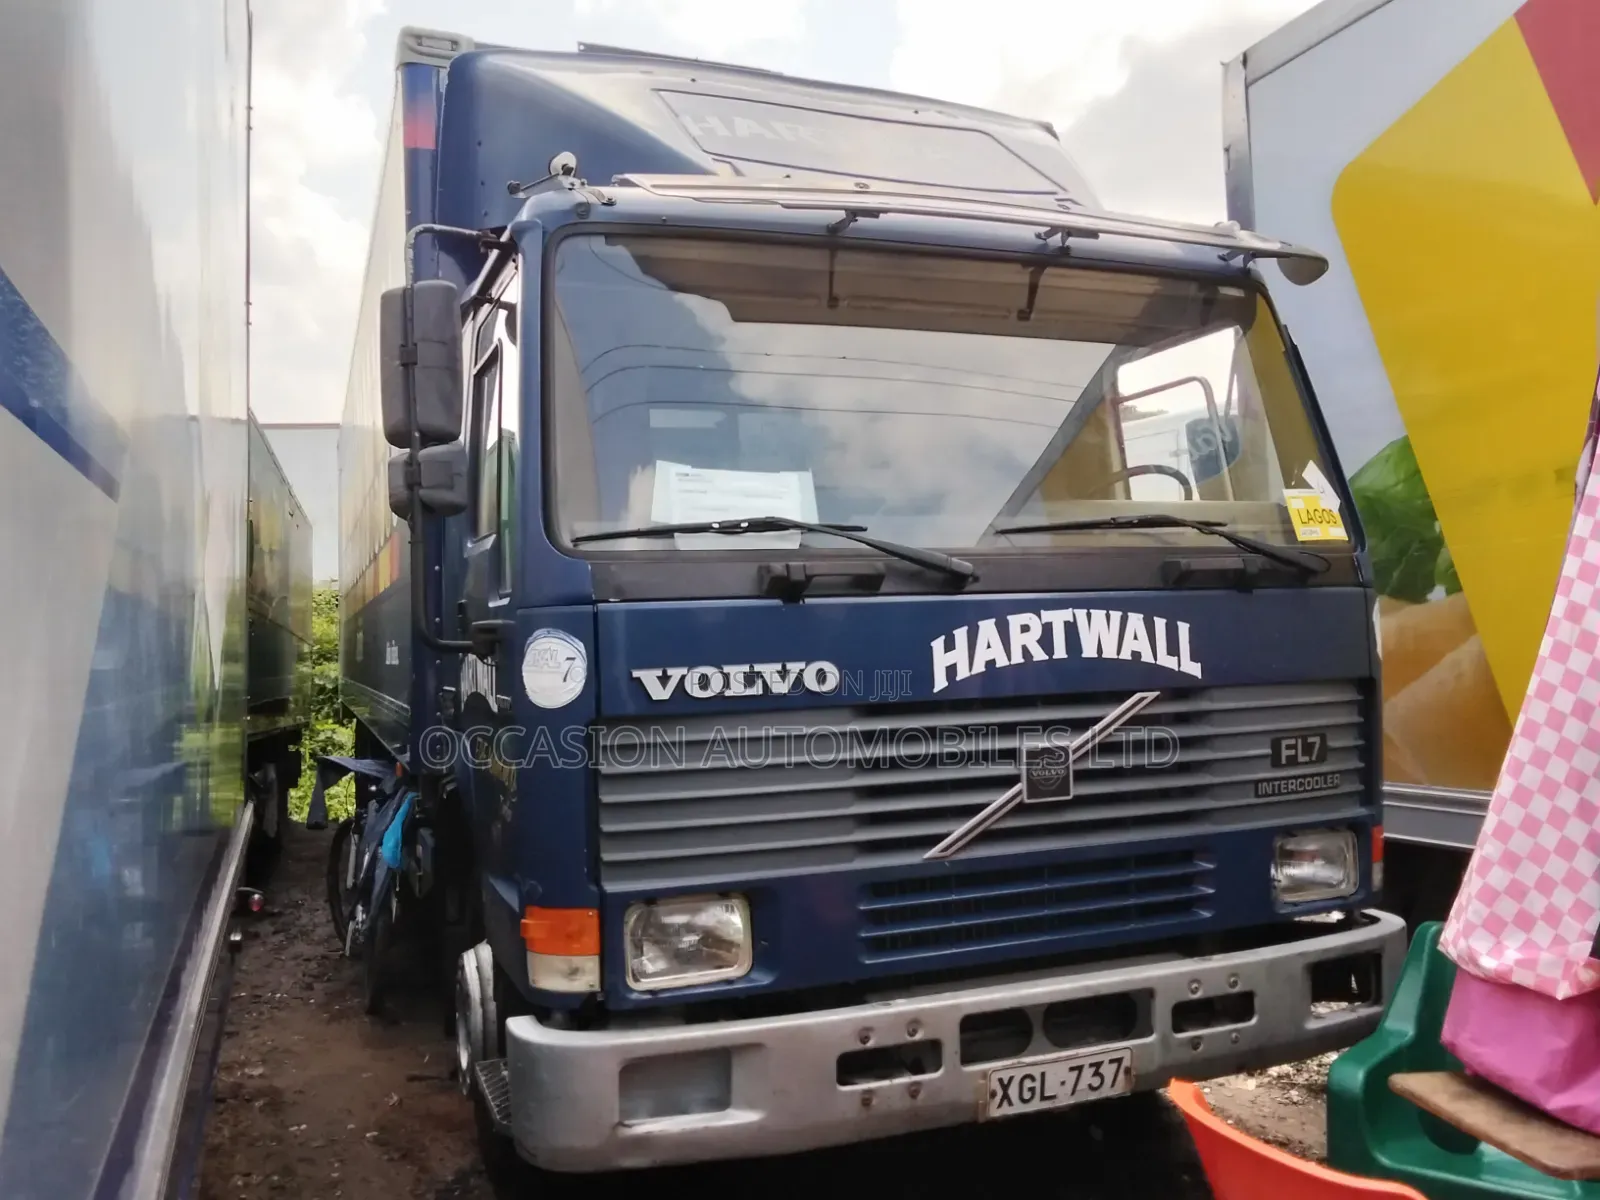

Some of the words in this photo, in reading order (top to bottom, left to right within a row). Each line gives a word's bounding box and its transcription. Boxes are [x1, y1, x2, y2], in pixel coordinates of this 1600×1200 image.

[1297, 508, 1338, 525] LAGOS
[930, 608, 1202, 693] HARTWALL
[562, 656, 577, 683] 7
[631, 660, 840, 700] VOLVO
[1280, 735, 1321, 765] FL7
[1031, 768, 1065, 777] VOLVO
[1257, 773, 1341, 796] INTERCOOLER
